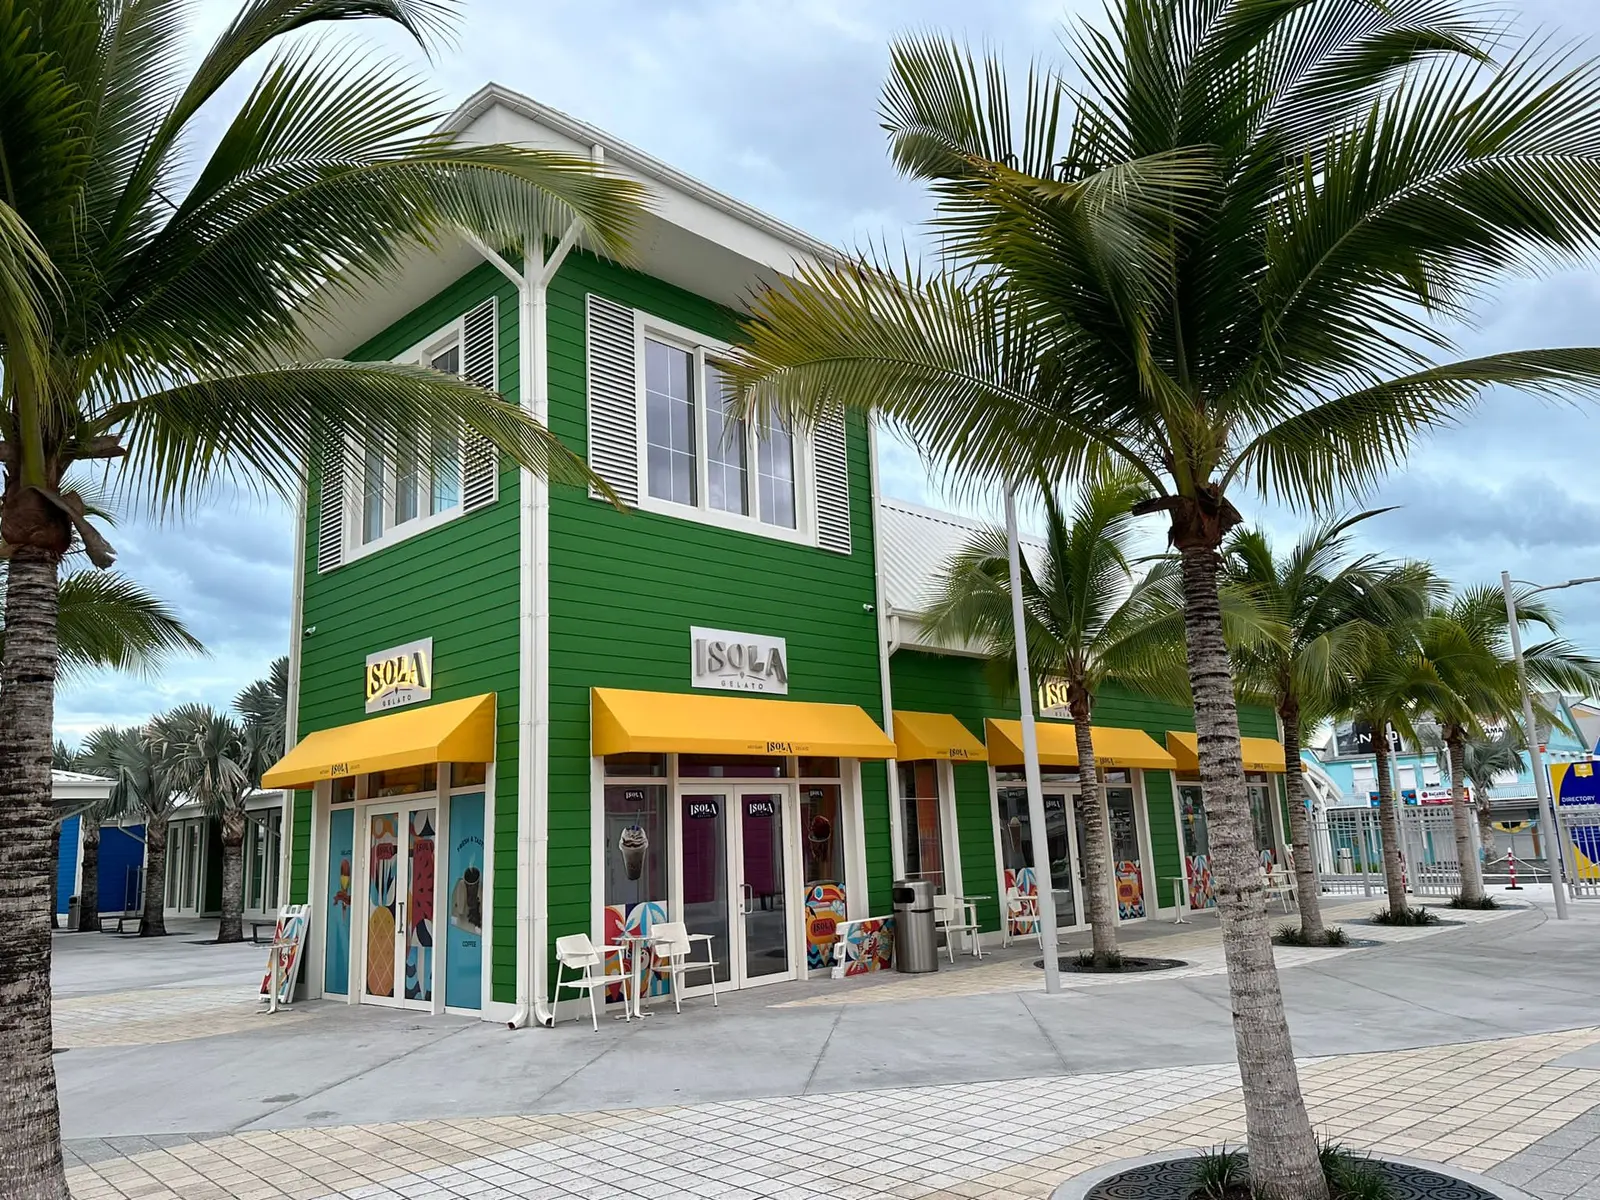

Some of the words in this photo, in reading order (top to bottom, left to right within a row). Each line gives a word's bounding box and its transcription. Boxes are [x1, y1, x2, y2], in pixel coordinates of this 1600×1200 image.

[695, 638, 787, 684] ISOLA
[365, 651, 427, 701] ISOLA
[721, 680, 764, 690] GELATO
[382, 694, 412, 707] GELATO
[1042, 683, 1068, 708] ISO
[766, 741, 793, 754] ISOLA
[949, 748, 968, 758] ISOLA
[331, 762, 348, 776] ISOLA
[625, 791, 643, 799] ISOLA
[690, 803, 717, 816] ISOLA
[749, 803, 773, 814] ISOLA
[813, 922, 835, 934] ISOLA
